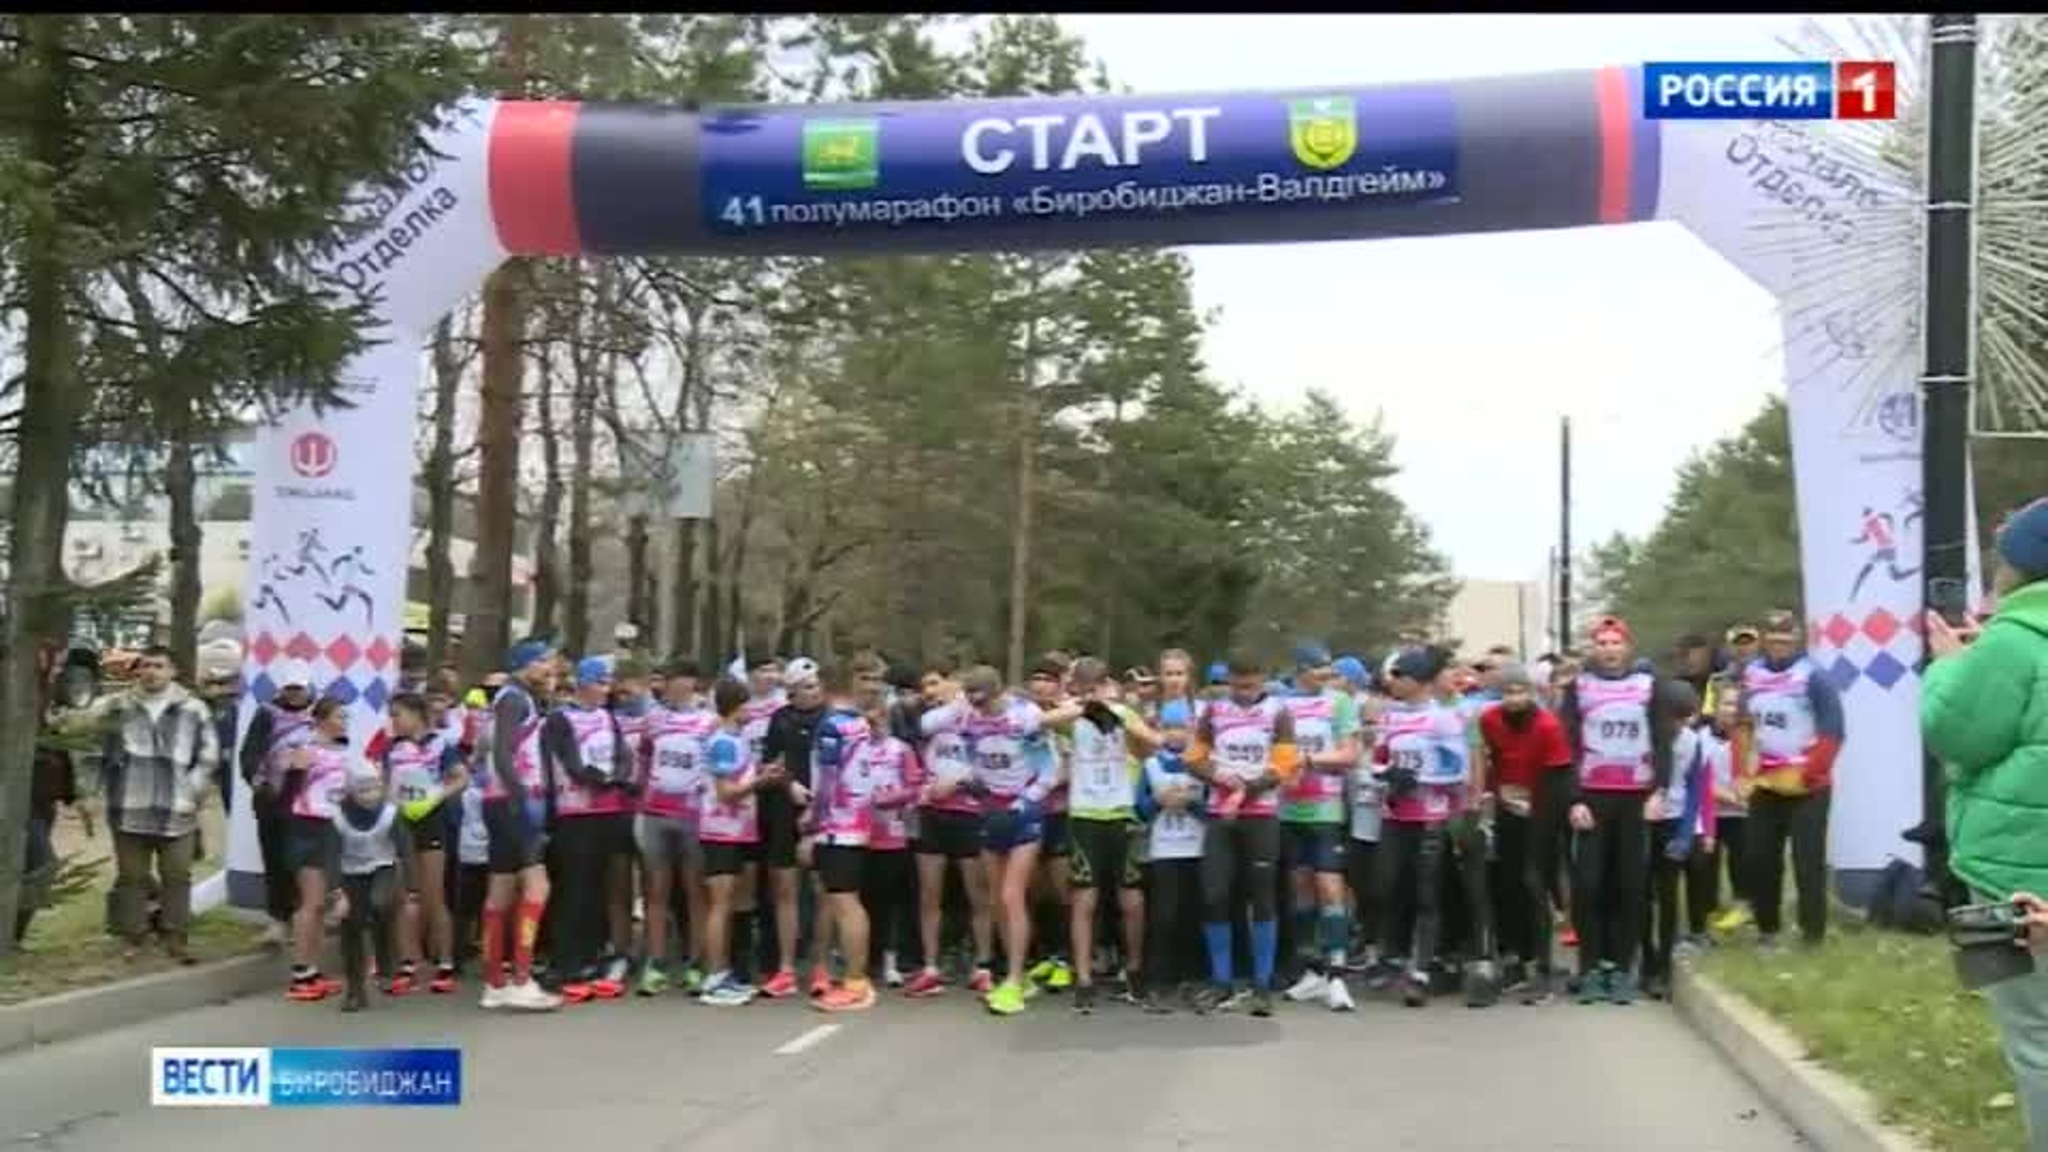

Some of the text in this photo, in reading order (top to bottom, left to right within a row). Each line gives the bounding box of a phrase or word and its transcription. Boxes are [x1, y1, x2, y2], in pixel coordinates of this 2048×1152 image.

[960, 106, 1222, 174] СТАРТ
[336, 187, 458, 290] Отделка
[721, 195, 765, 226] 41
[770, 191, 1000, 227] полумарафон
